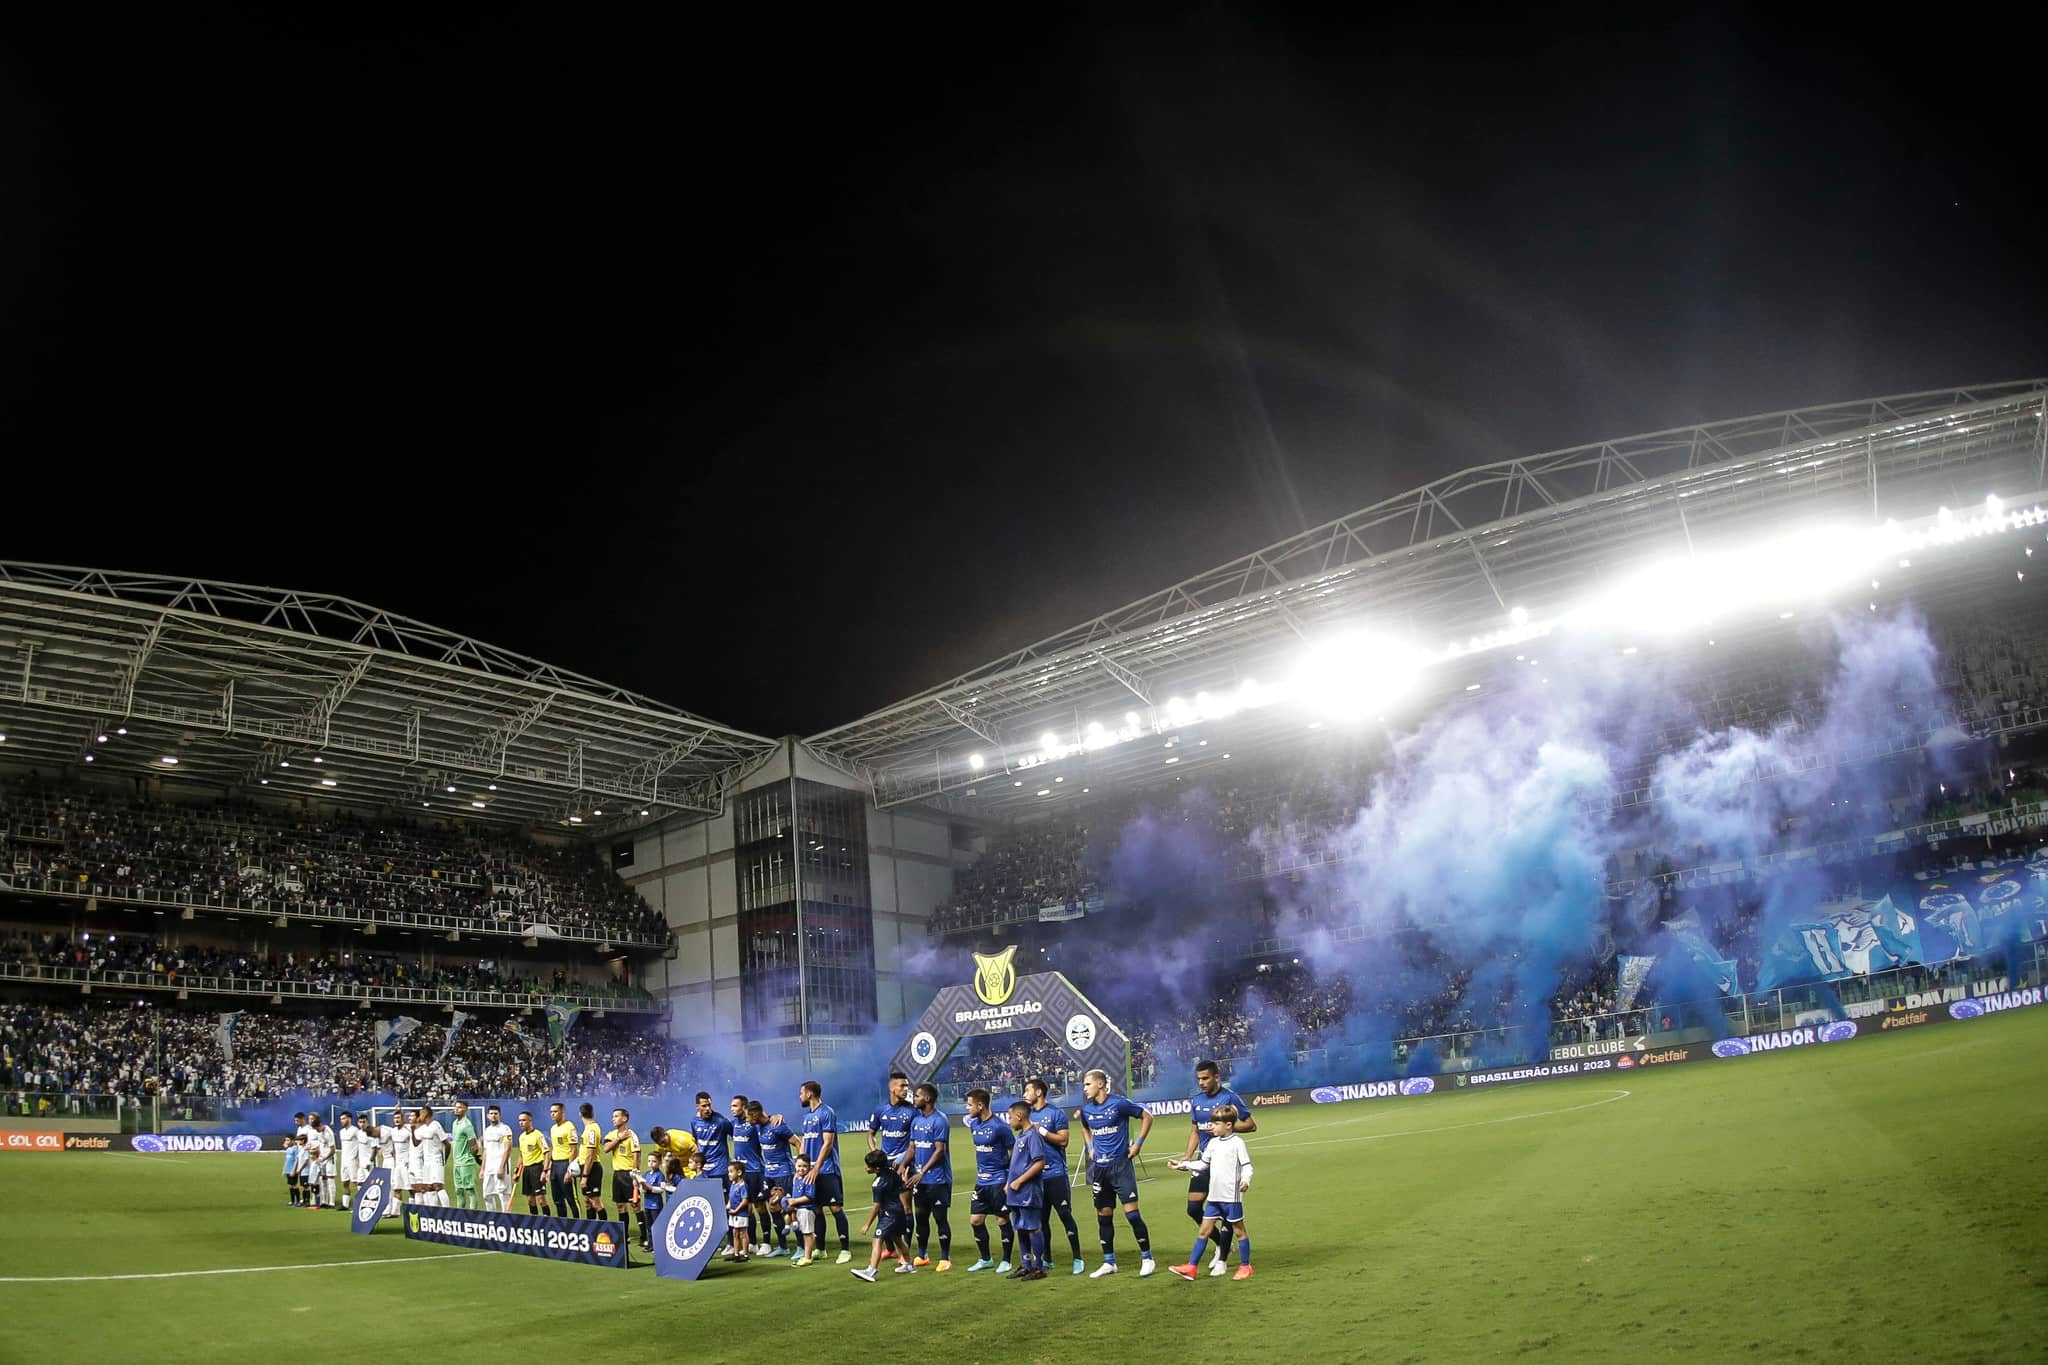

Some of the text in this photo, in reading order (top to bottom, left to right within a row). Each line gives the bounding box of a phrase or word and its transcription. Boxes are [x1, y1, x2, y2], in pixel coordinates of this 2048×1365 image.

[955, 1000, 1042, 1023] BRASILEIRÃO
[984, 1017, 1012, 1031] ASSAÍ
[1891, 1011, 1928, 1027] betfair
[1588, 1040, 1626, 1055] CLUBE
[1649, 1049, 1688, 1063] betfair
[1470, 1066, 1550, 1084] BRASILEIRÃO
[1551, 1063, 1579, 1075] ASSAÍ
[1583, 1060, 1611, 1071] 2023
[1261, 1093, 1292, 1105] betfair
[8, 1135, 32, 1147] GOL
[36, 1135, 60, 1147] GOL
[76, 1137, 111, 1148] betfair
[419, 1216, 508, 1242] BRASILEIRÃO
[509, 1227, 545, 1247] ASSAÍ
[547, 1230, 590, 1252] 2023
